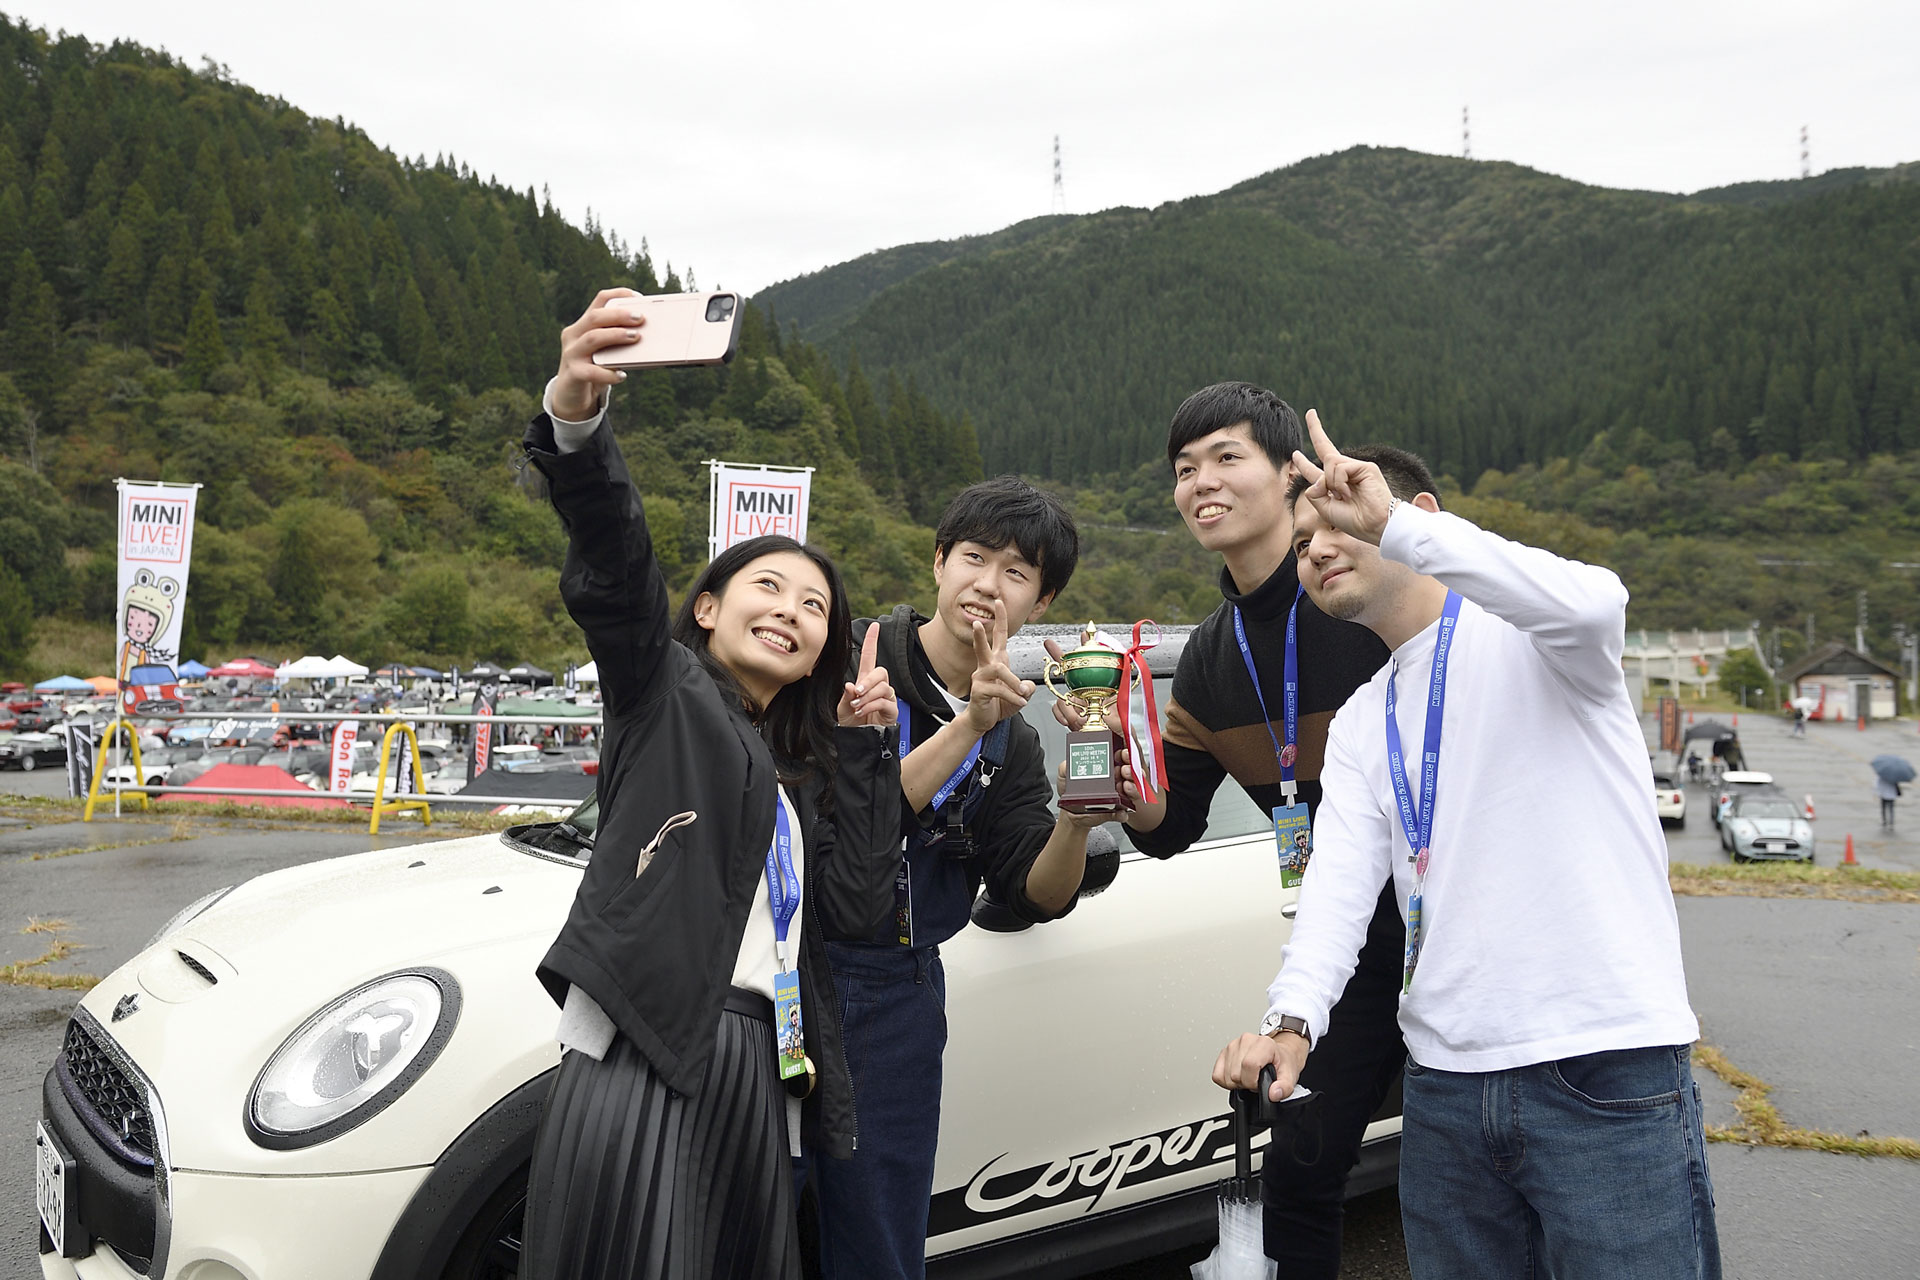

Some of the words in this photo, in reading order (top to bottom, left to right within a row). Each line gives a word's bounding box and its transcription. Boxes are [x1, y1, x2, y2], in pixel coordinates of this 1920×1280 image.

[737, 491, 793, 514] MINI
[132, 504, 182, 525] MINI
[735, 514, 792, 538] LIVE!
[130, 525, 180, 546] LIVE!
[1438, 627, 1451, 662] MEETING
[1435, 661, 1444, 684] LIVE!
[1432, 684, 1441, 707] MINI
[340, 730, 355, 760] Bon
[338, 768, 351, 792] Ra
[1392, 752, 1401, 772] MINI
[1400, 794, 1415, 831] MEETING
[1424, 764, 1434, 801] MEETING
[1422, 802, 1431, 823] LIVE!
[1420, 824, 1429, 847] MINI
[1287, 878, 1303, 887] GUE
[965, 1119, 1230, 1213] Cooper
